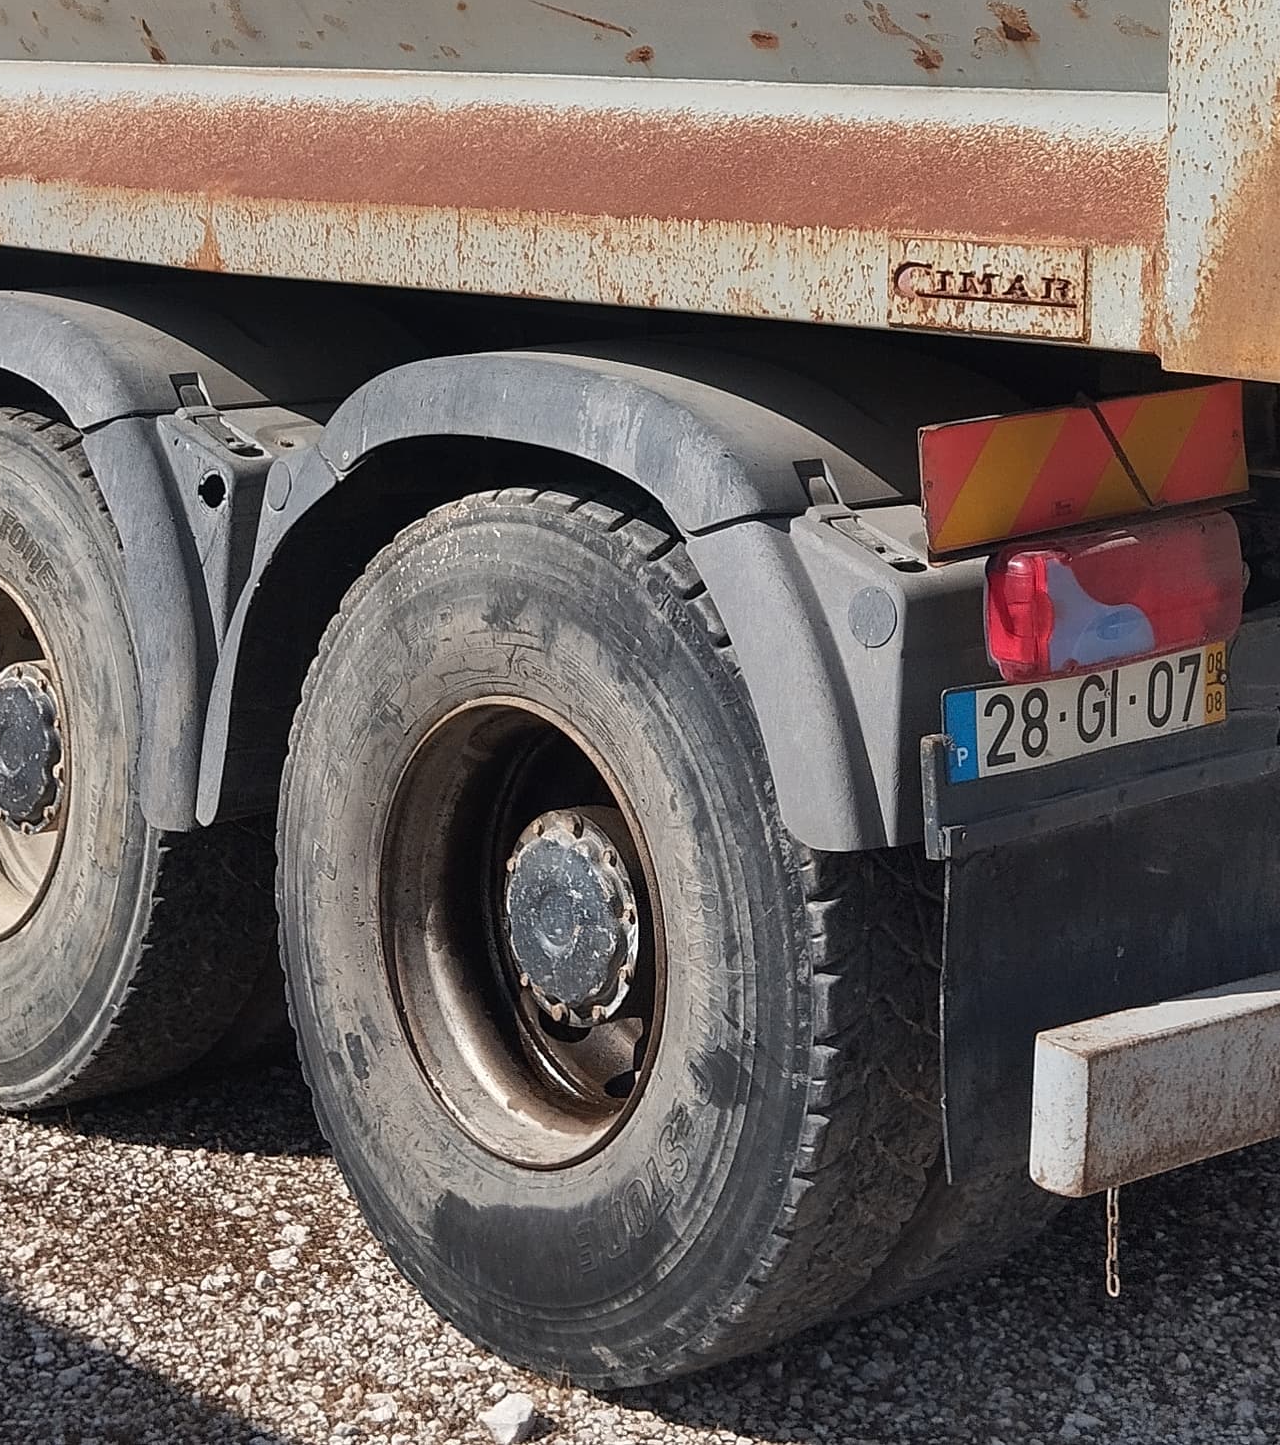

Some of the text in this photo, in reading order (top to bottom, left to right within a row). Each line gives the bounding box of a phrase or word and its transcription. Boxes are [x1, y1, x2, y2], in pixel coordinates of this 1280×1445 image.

[893, 260, 1077, 305] CIMAR
[1206, 650, 1224, 676] 08
[1205, 691, 1224, 715] 08
[955, 746, 969, 768] P
